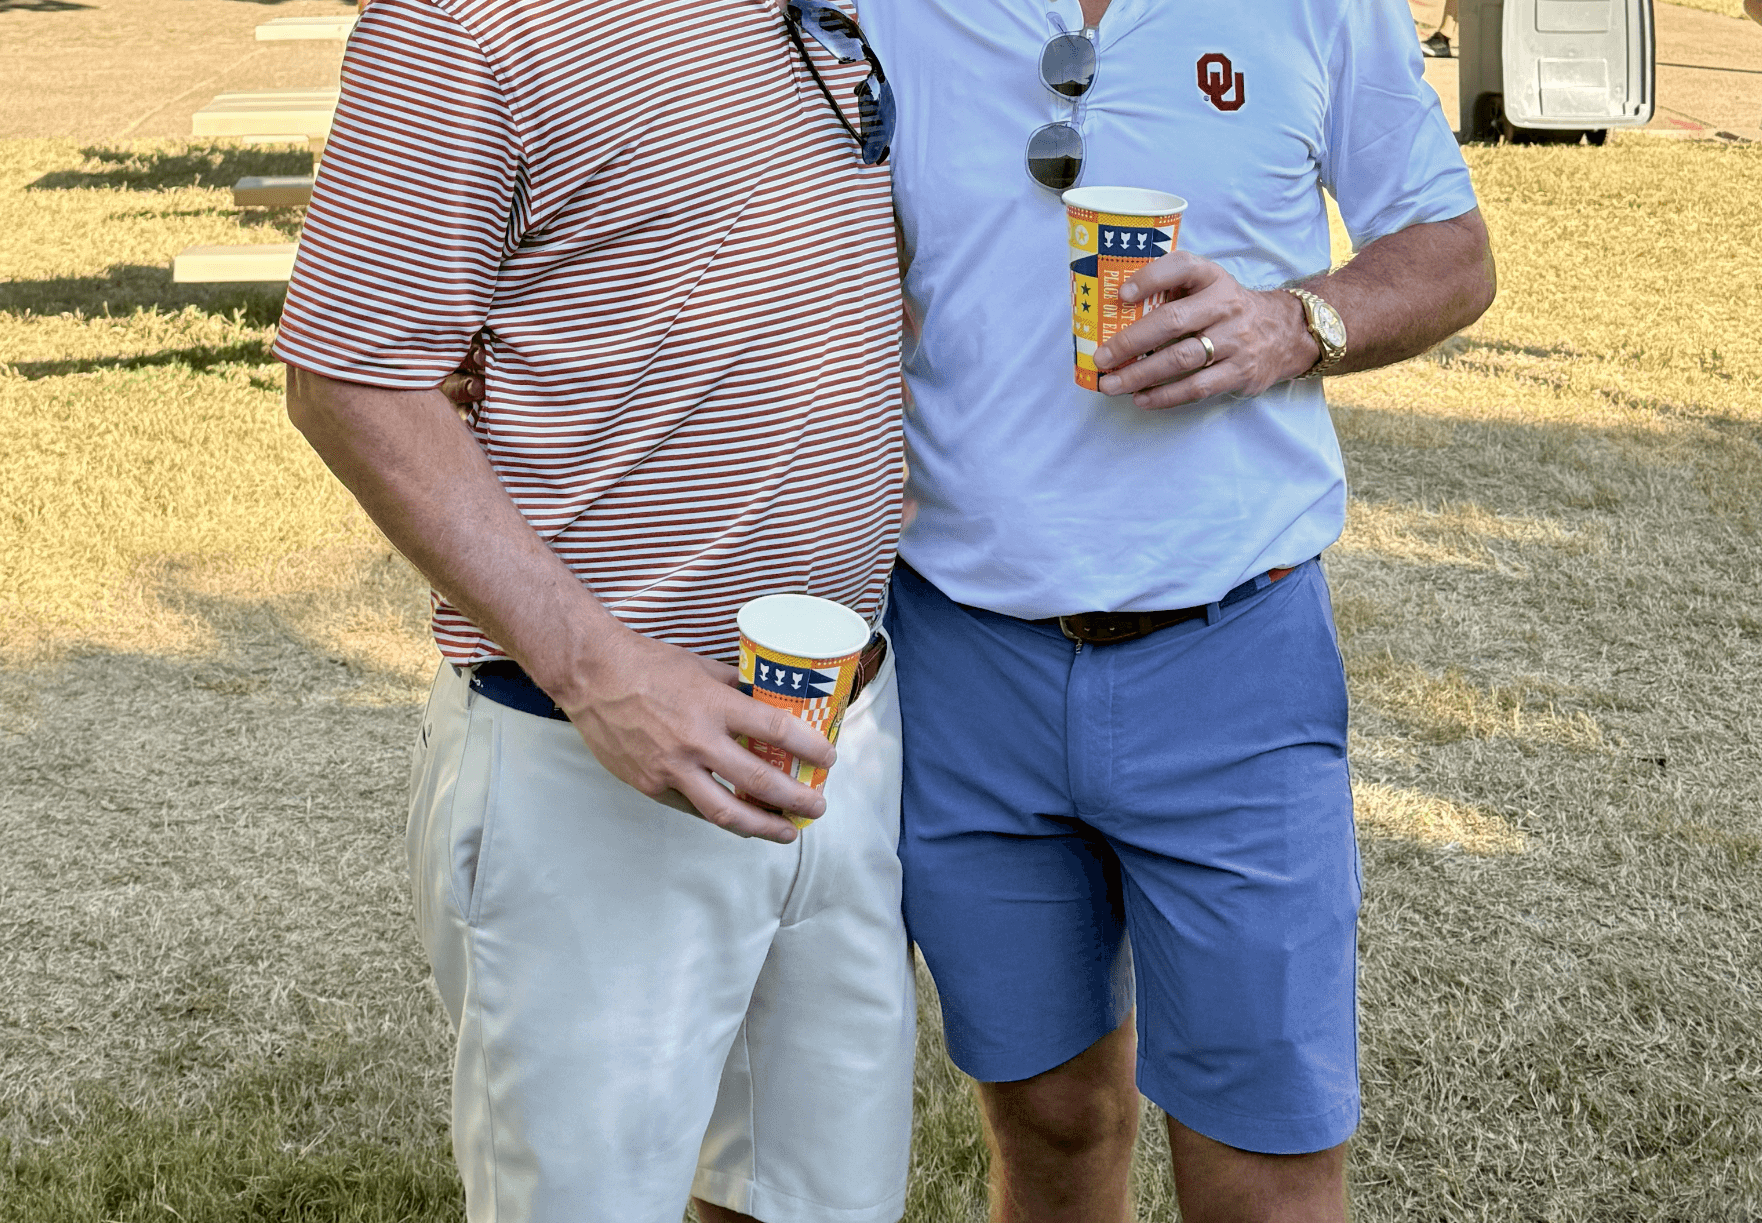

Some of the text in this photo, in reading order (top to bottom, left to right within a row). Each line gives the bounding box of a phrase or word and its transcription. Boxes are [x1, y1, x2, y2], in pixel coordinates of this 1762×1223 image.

[1196, 52, 1246, 112] OU
[1103, 269, 1120, 299] PLACE
[1103, 304, 1118, 318] ON
